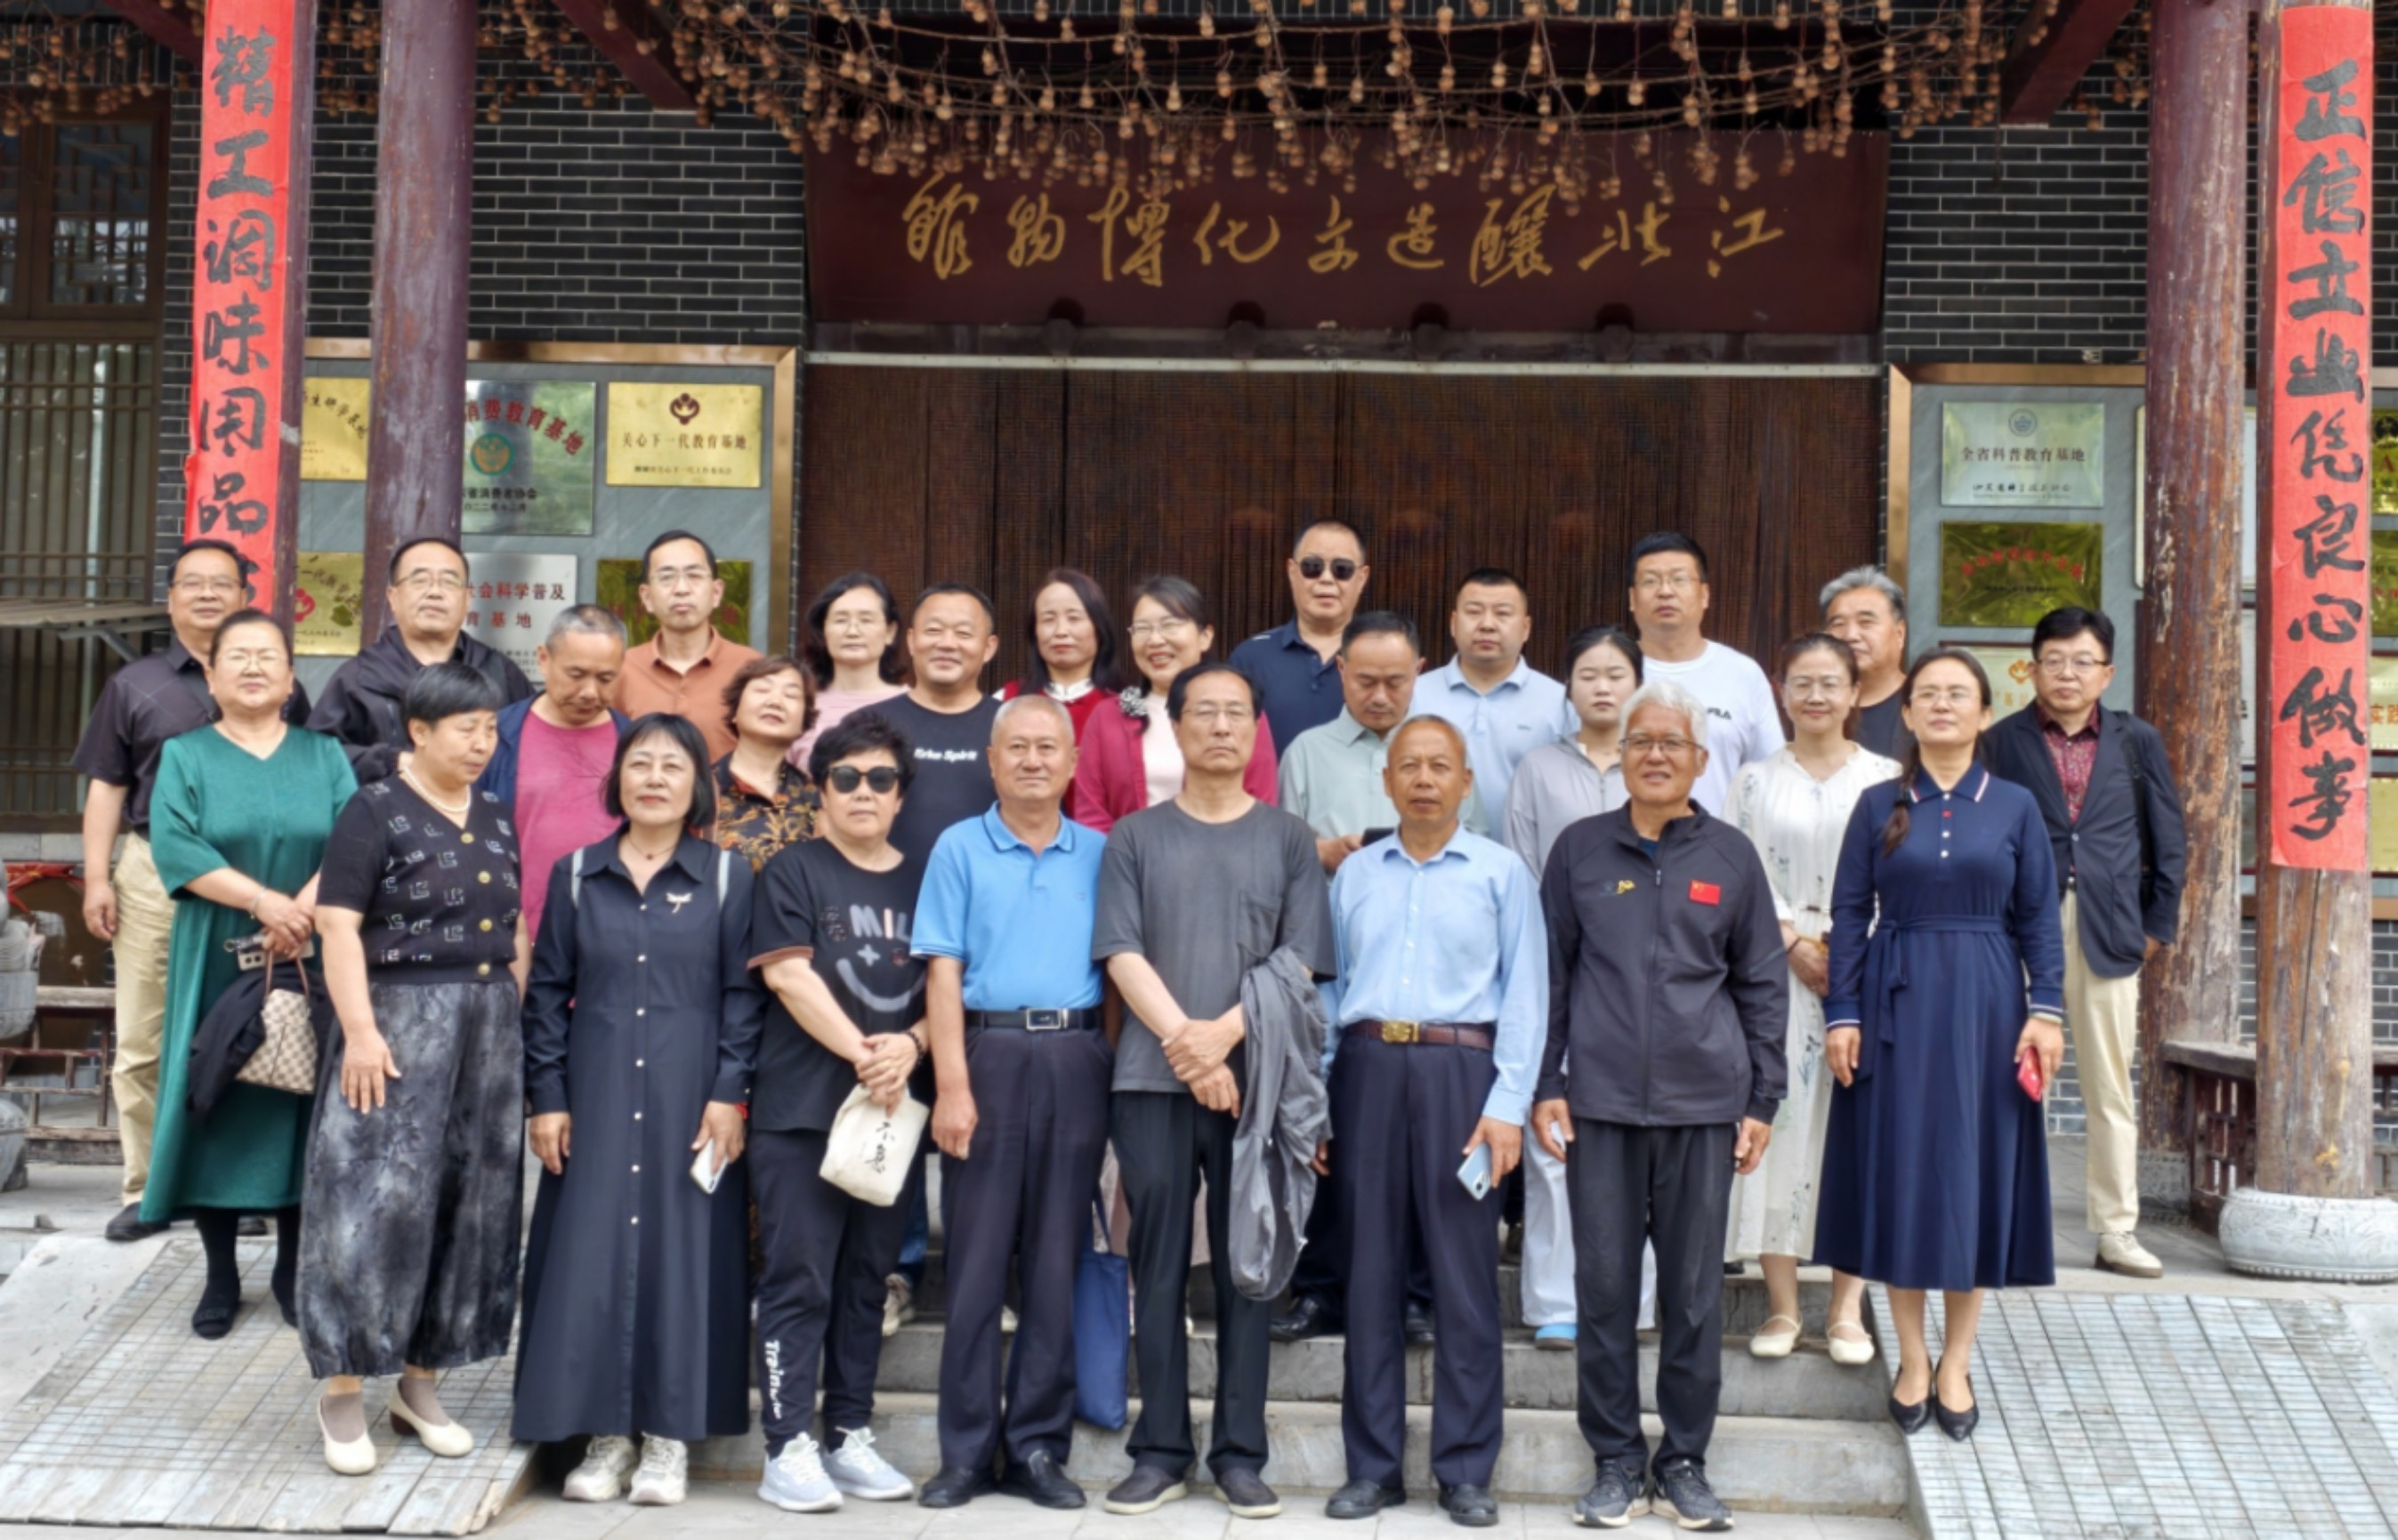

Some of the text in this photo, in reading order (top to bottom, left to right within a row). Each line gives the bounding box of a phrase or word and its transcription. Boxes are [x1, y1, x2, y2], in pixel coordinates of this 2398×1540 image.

[1961, 447, 2086, 463] 全省科普教育基地
[461, 488, 537, 500] 省消费者协会
